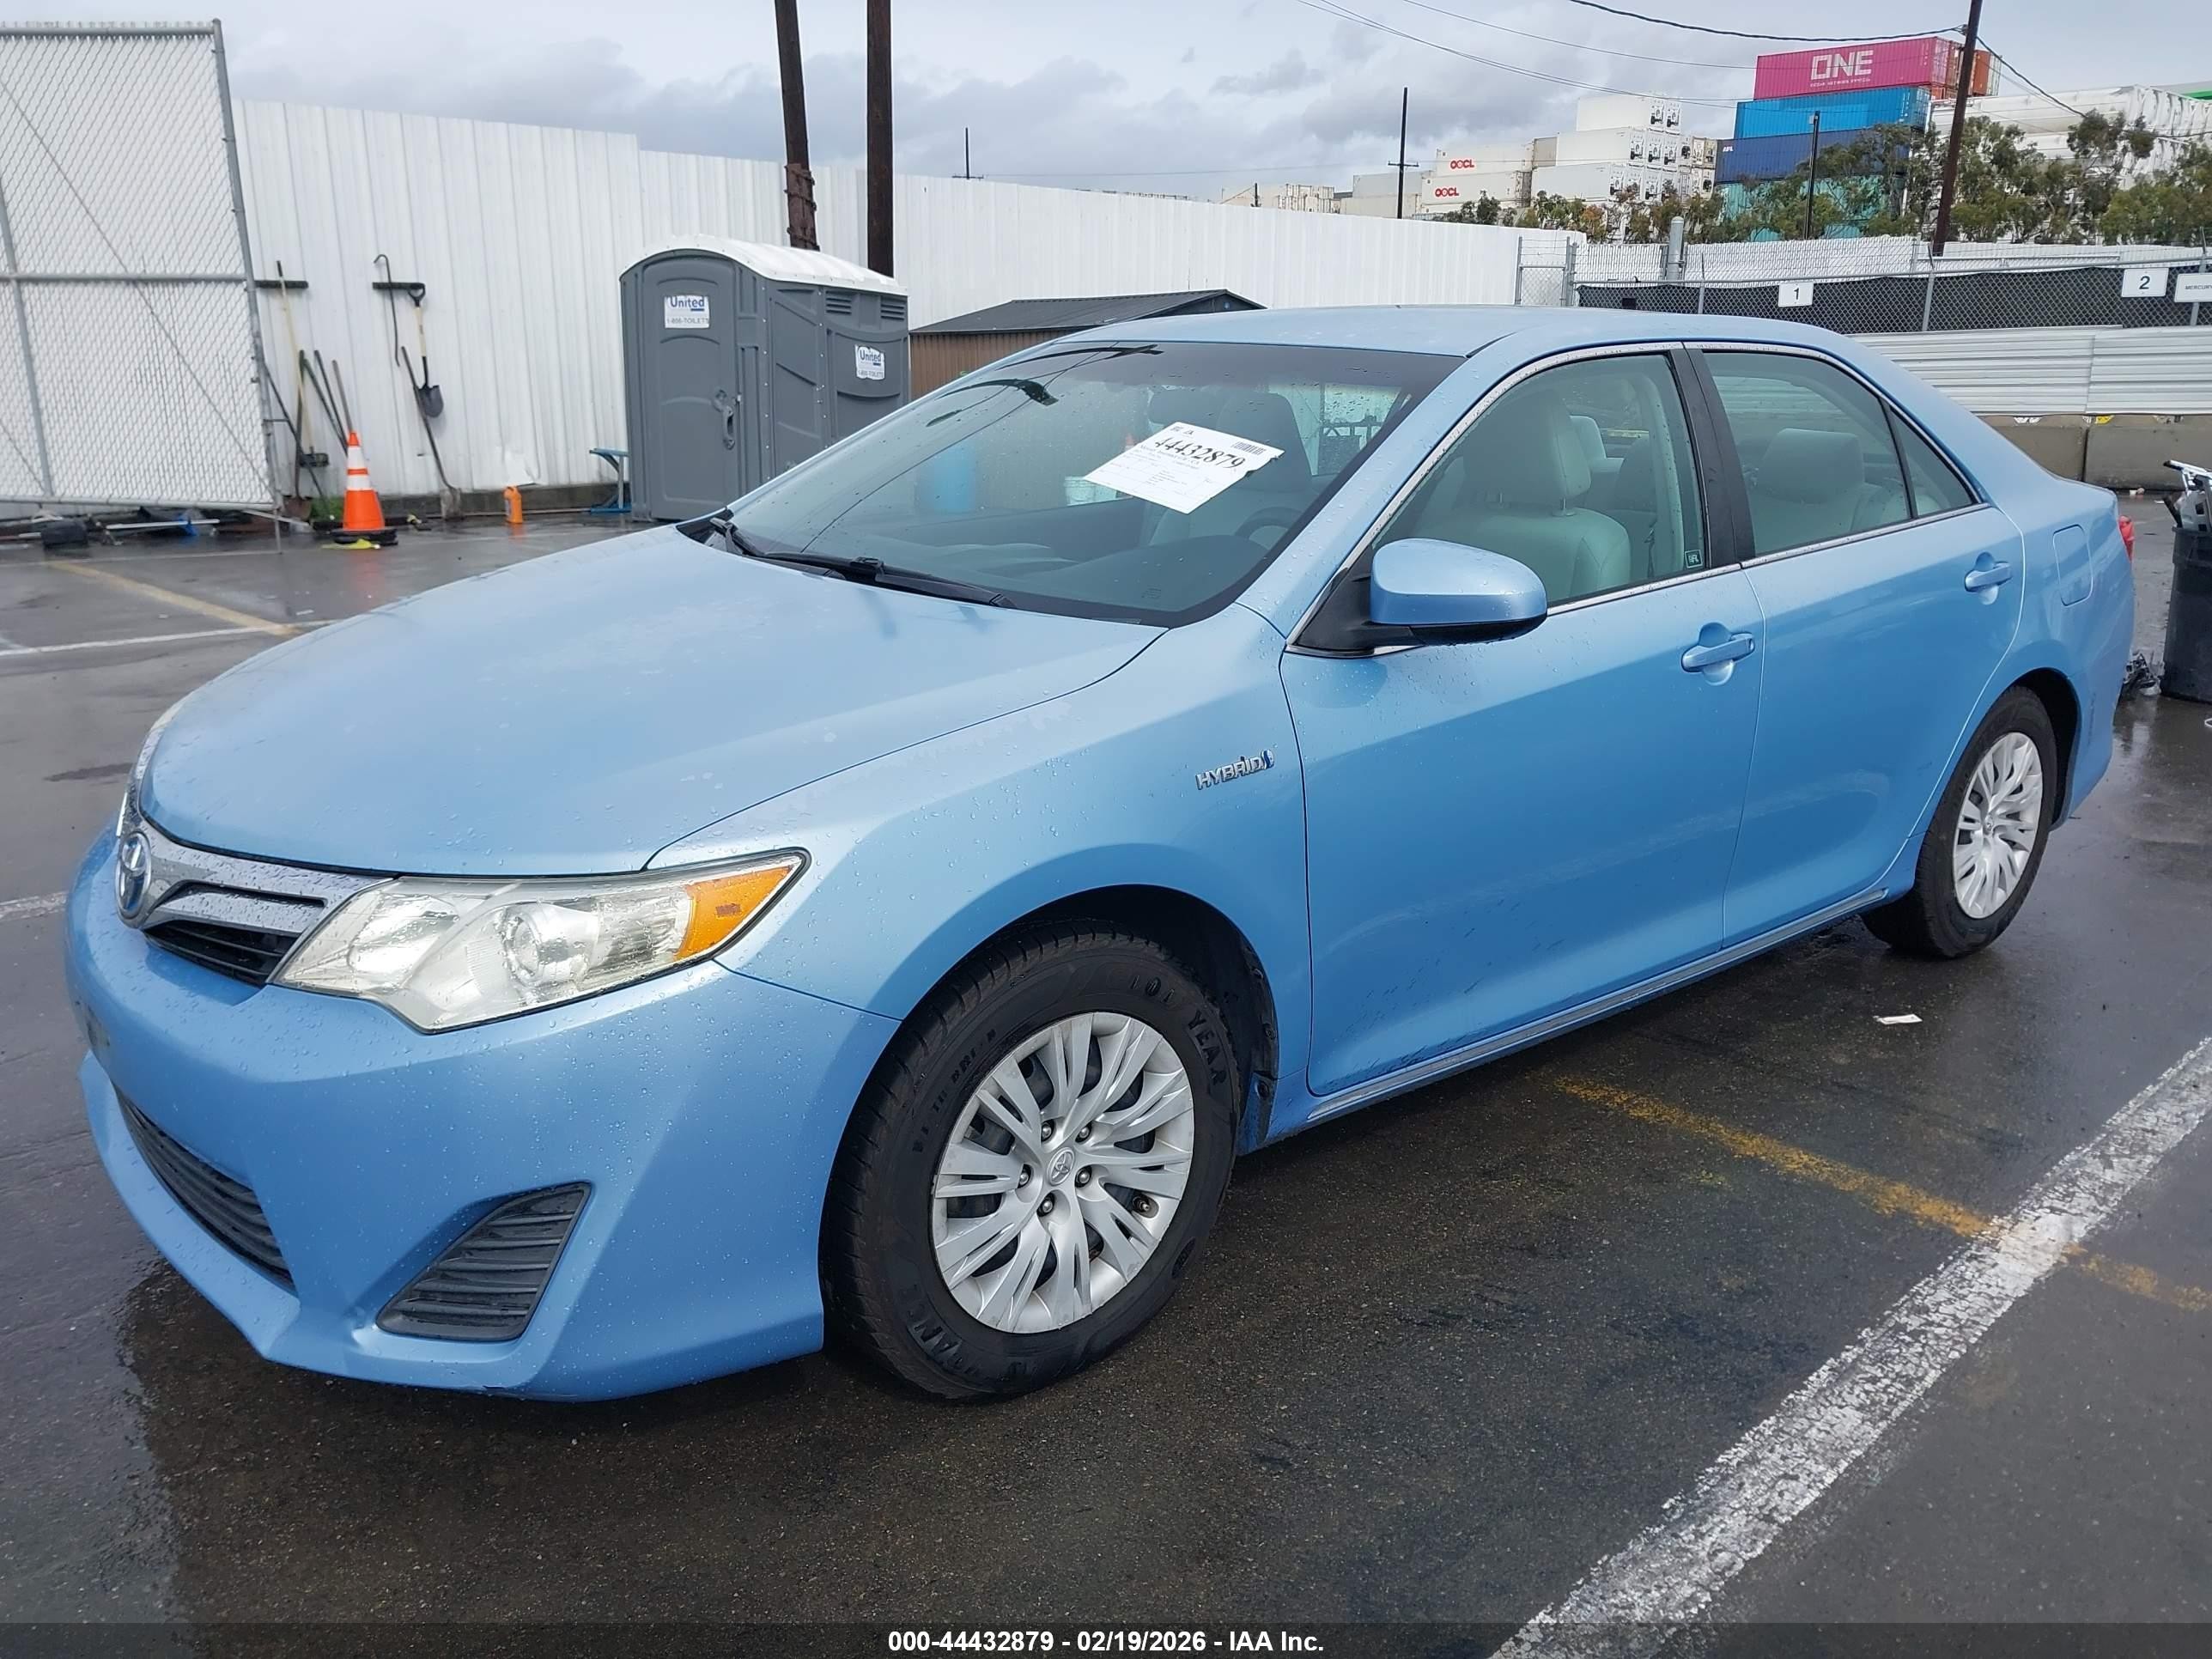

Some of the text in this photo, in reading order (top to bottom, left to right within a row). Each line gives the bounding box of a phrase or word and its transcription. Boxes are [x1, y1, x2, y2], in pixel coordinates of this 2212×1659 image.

[1811, 50, 1874, 80] ONE
[1449, 159, 1474, 169] OOCL
[1435, 186, 1460, 198] OOCL
[2139, 275, 2150, 289] 2
[1794, 287, 1800, 300] 1
[670, 295, 705, 307] United
[860, 349, 882, 362] United
[1154, 437, 1245, 469] 44432879
[1195, 756, 1267, 790] HYBRID
